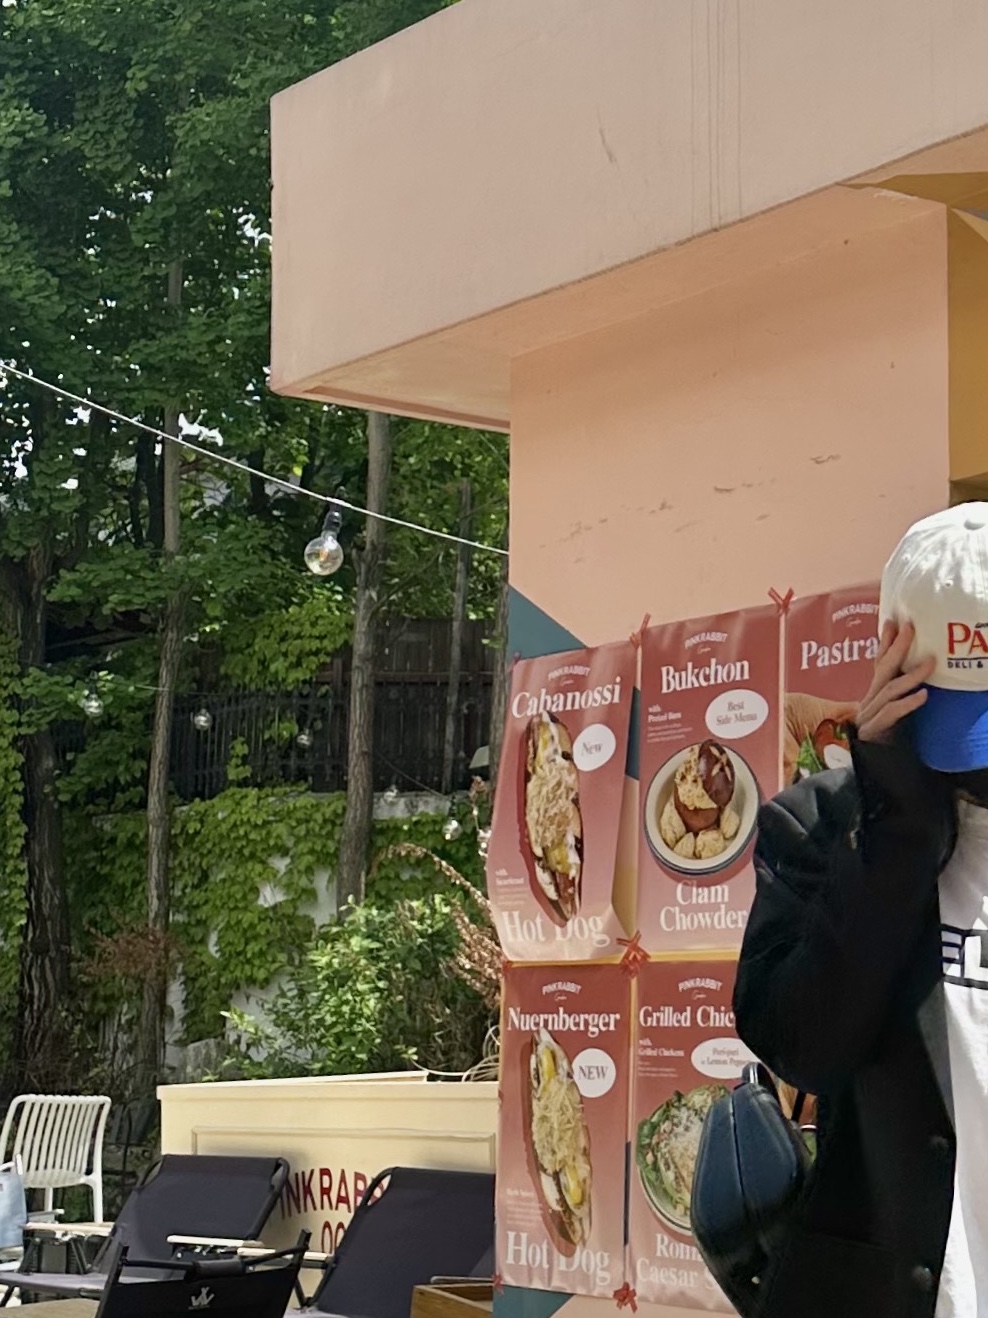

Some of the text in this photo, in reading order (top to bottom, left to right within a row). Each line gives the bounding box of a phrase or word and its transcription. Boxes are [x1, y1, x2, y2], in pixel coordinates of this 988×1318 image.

[800, 635, 879, 671] Pastra
[947, 661, 972, 669] DELI
[976, 660, 984, 669] &
[660, 658, 750, 694] Bukchon
[511, 676, 621, 719] Cabanossi
[582, 742, 603, 755] New
[676, 880, 729, 905] Clam
[501, 911, 611, 948] Hot Dog
[660, 904, 748, 932] Chowder
[507, 1006, 621, 1038] Nuernberger
[639, 1005, 736, 1028] Grilled Chic
[578, 1065, 609, 1080] NEW
[281, 1167, 386, 1220] INKRAB
[505, 1230, 611, 1287] Hot Dog
[636, 1257, 699, 1288] Caesar
